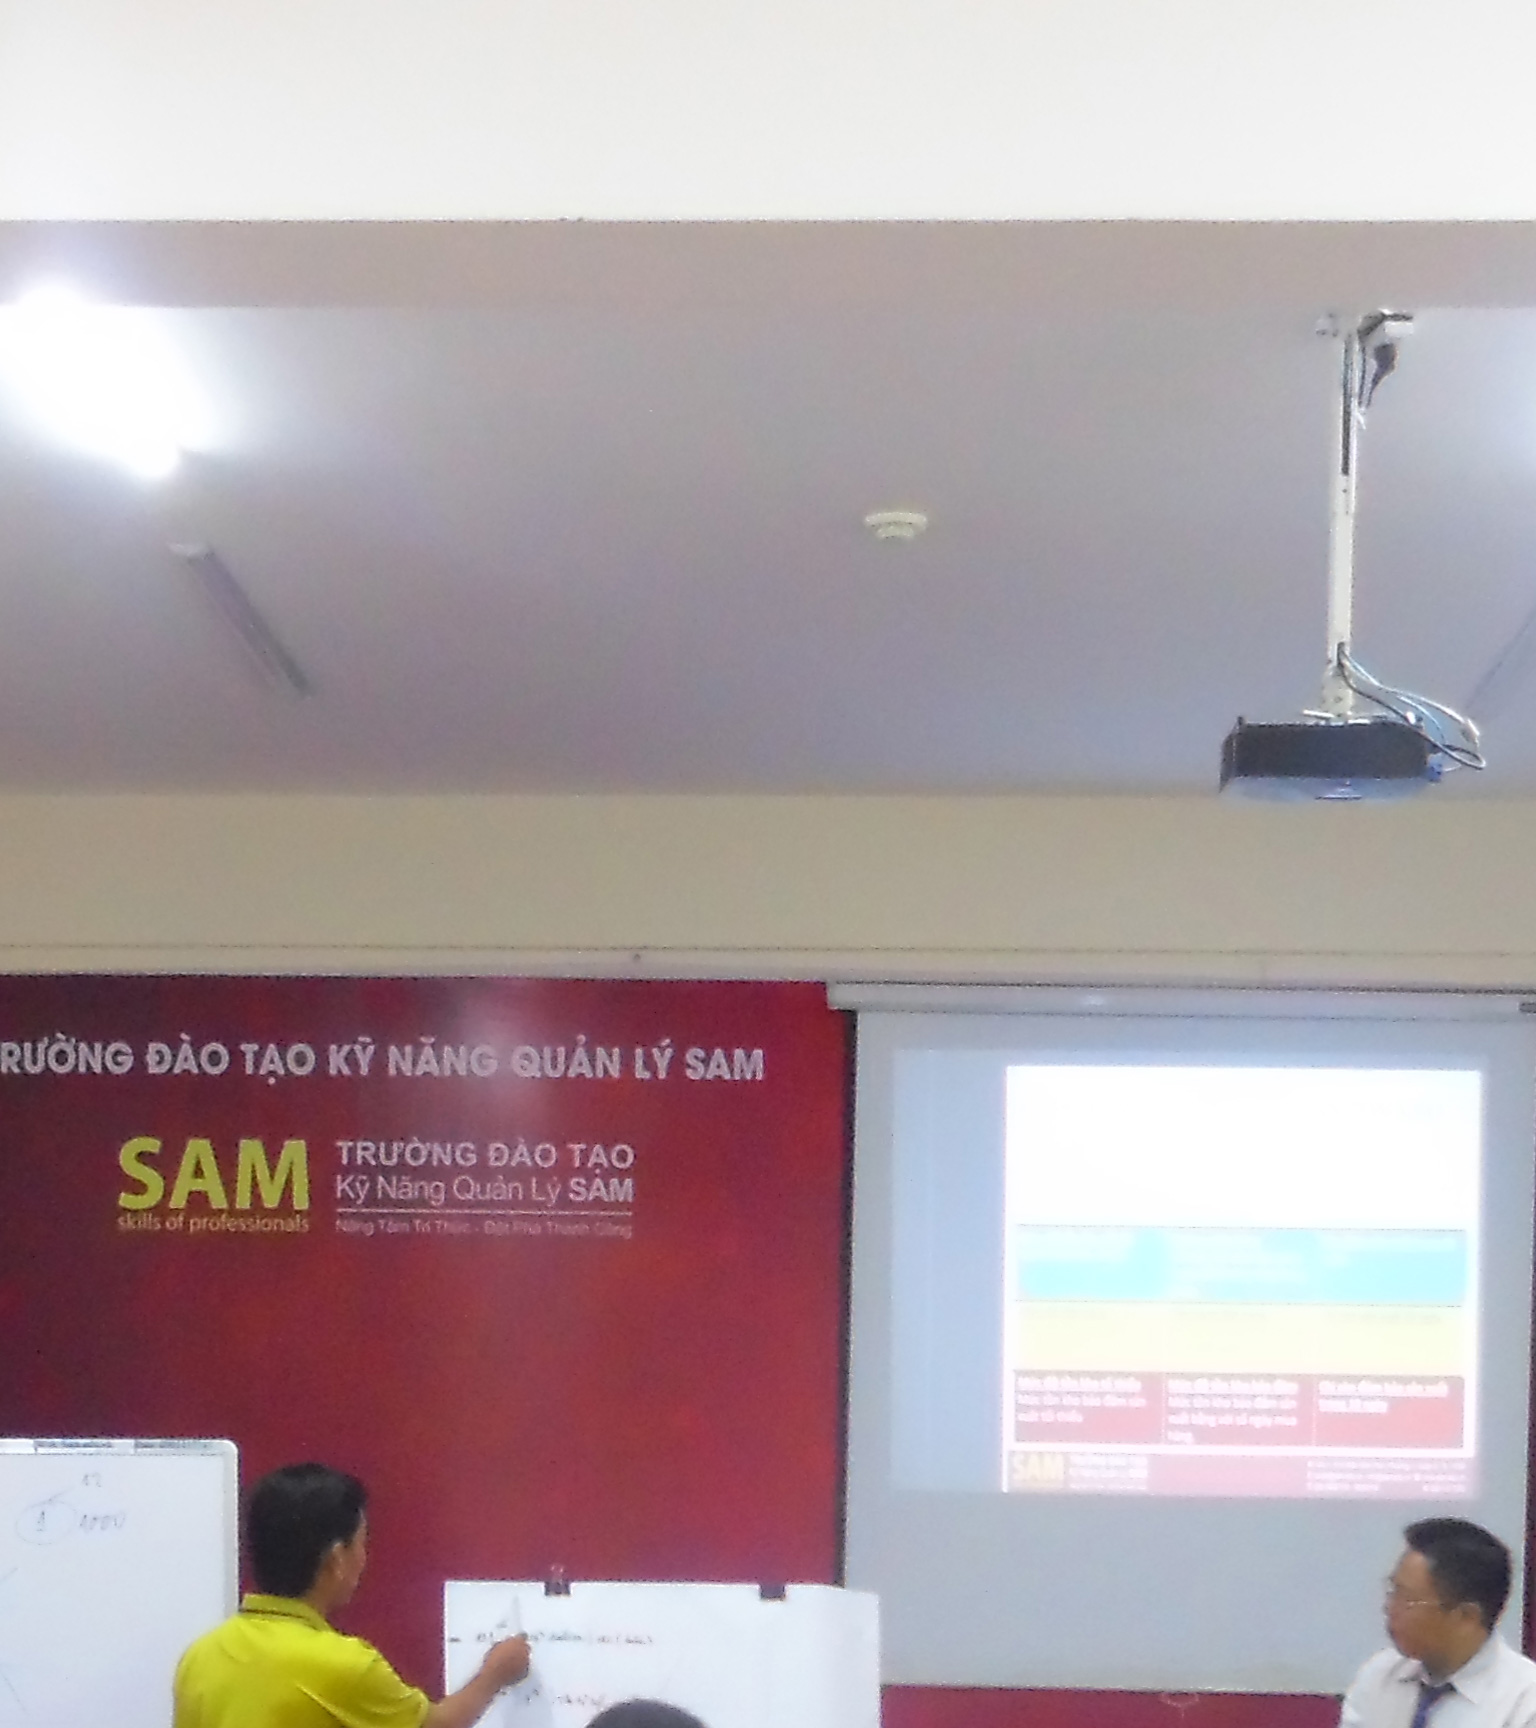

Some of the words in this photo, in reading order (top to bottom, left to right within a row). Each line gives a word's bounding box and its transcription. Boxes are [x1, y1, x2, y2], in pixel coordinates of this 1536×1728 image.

[146, 1033, 230, 1075] ĐÀO
[240, 1042, 317, 1085] TẠO
[328, 1036, 375, 1077] KỸ
[388, 1036, 499, 1078] NĂNG
[511, 1034, 621, 1079] QUẢN
[635, 1038, 674, 1080] LÝ
[685, 1047, 764, 1081] SAM
[118, 1135, 310, 1211] SAM
[336, 1136, 477, 1168] TRƯỜNG
[488, 1138, 558, 1169] ĐÀO
[567, 1143, 635, 1174] TẠO
[377, 1175, 446, 1207] Năng
[569, 1177, 634, 1203] SAM
[118, 1213, 162, 1231] skills
[165, 1213, 185, 1232] of
[189, 1213, 310, 1234] professionals
